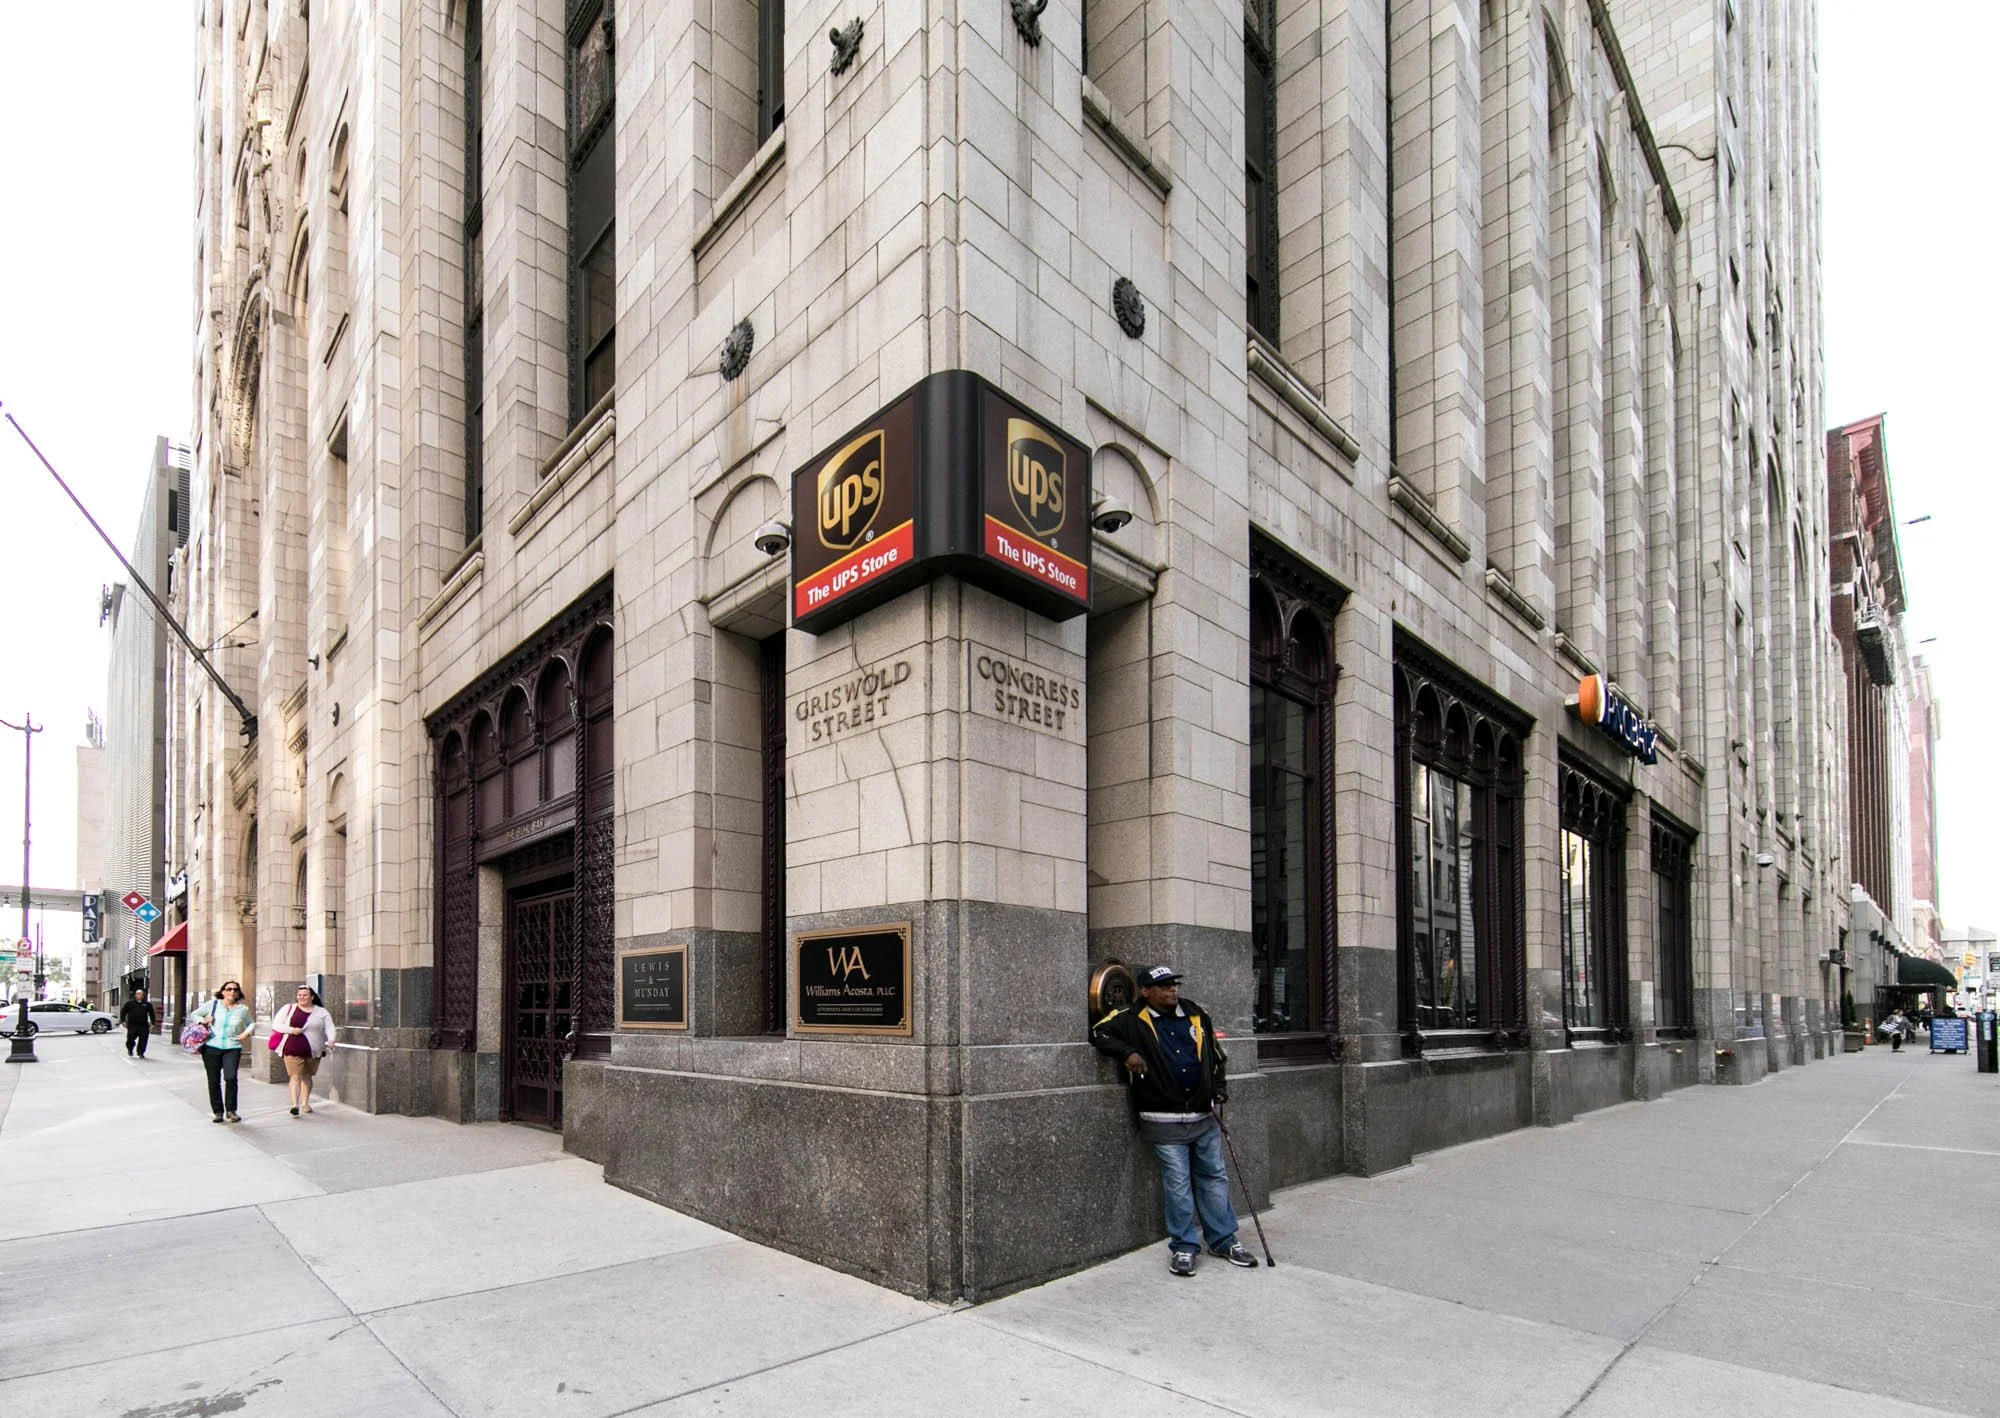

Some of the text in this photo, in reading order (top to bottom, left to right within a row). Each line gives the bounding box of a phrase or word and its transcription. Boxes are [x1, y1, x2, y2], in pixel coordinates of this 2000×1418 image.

[807, 547, 898, 606] The UPS Store
[997, 535, 1077, 590] The UPS Store
[795, 660, 912, 722] GRISWOLD
[976, 655, 1080, 710] CONGRESS
[811, 695, 890, 742] STREET
[994, 688, 1065, 730] STREET
[84, 896, 98, 942] PARK
[633, 960, 671, 973] LEWIS
[648, 975, 654, 985] &
[634, 986, 670, 998] MUNDAY
[805, 985, 841, 997] Williams
[876, 986, 896, 996] PLLC
